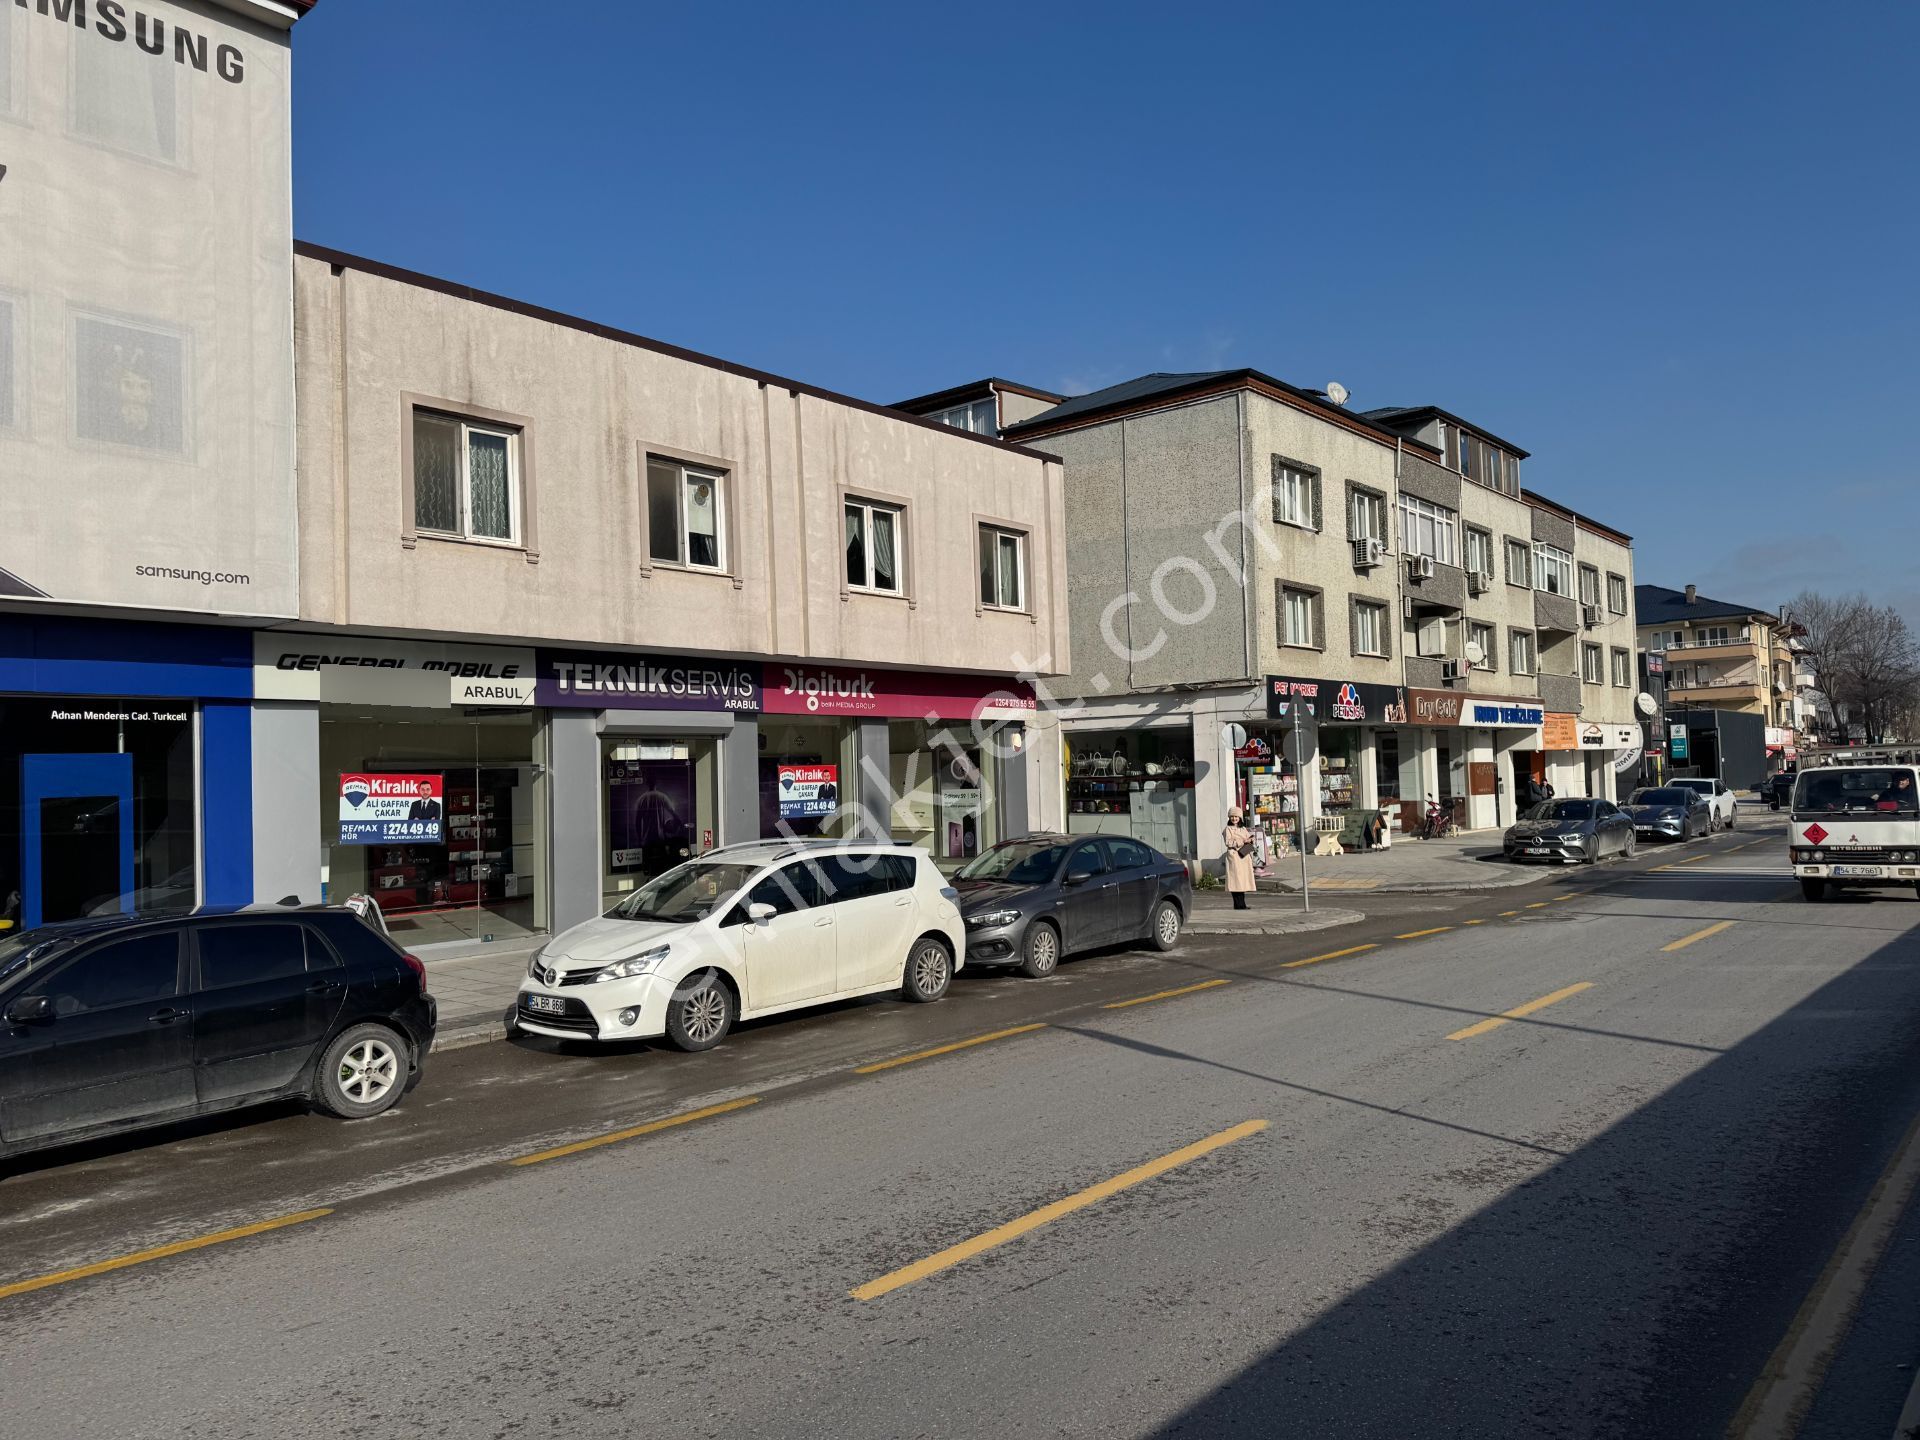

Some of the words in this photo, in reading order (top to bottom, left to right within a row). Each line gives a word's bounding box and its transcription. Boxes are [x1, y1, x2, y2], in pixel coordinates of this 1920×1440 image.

[15, 0, 244, 84] MSUNG
[135, 565, 250, 585] samsung.com
[553, 661, 669, 693] TEKNİK
[671, 667, 753, 697] SERVİS
[464, 686, 523, 699] ARABUL
[784, 668, 875, 711] Digiturk
[1274, 682, 1288, 695] PET
[724, 699, 760, 710] ARABUL
[1416, 697, 1435, 721] Dry
[51, 710, 82, 720] Adnan
[84, 711, 129, 720] Menderes
[131, 711, 150, 721] Cad.
[153, 712, 187, 721] Turkcell
[795, 769, 823, 781] Kiralık
[371, 779, 419, 794] Kiralık
[366, 798, 378, 808] ALİ
[380, 800, 410, 808] GAFFAR
[828, 801, 836, 810] 49
[375, 809, 401, 818] ÇAKAR
[342, 824, 378, 833] RE/MAX
[388, 823, 408, 835] 274
[409, 823, 423, 834] 49
[425, 823, 439, 834] 49
